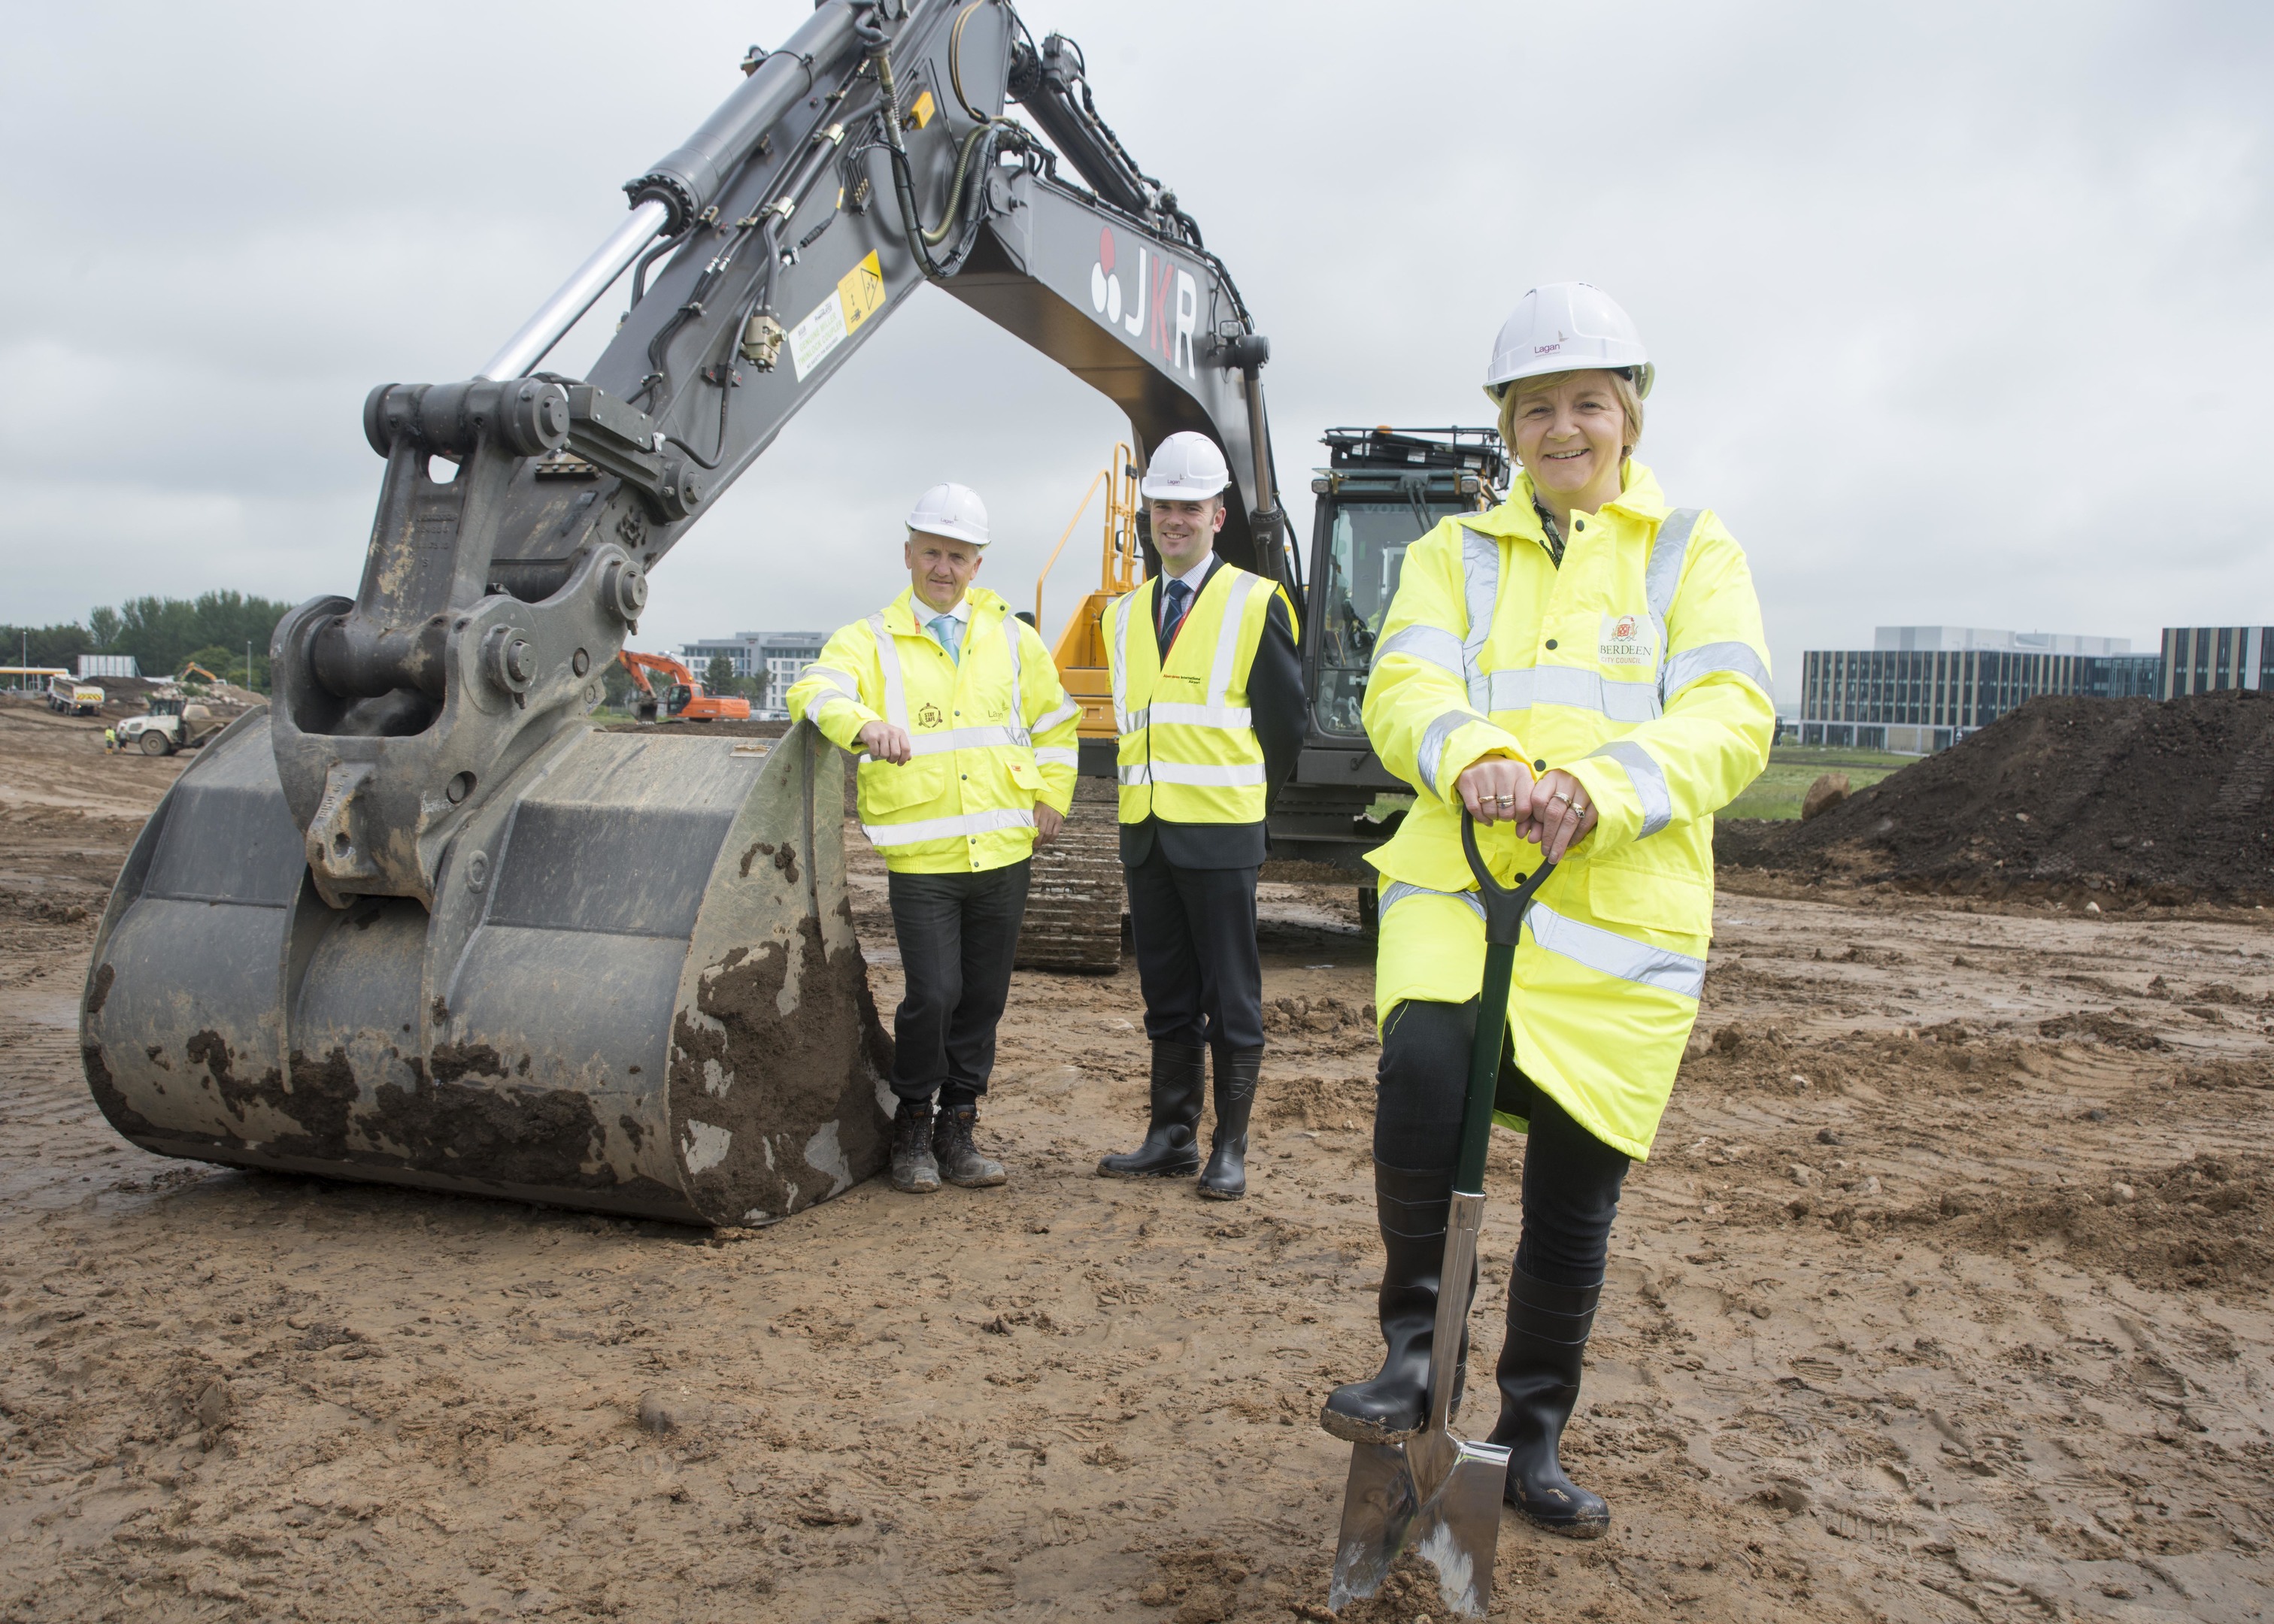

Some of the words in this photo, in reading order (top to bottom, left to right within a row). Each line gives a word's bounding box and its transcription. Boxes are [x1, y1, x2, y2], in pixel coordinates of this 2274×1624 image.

[799, 328, 820, 352] GENUINE
[820, 312, 836, 331] MILLER
[1125, 246, 1196, 380] JKR
[798, 339, 822, 367] TWINLOCK
[822, 319, 842, 344] COUPLER
[1535, 344, 1560, 353] Lagan
[1599, 645, 1652, 656] BERDEEN
